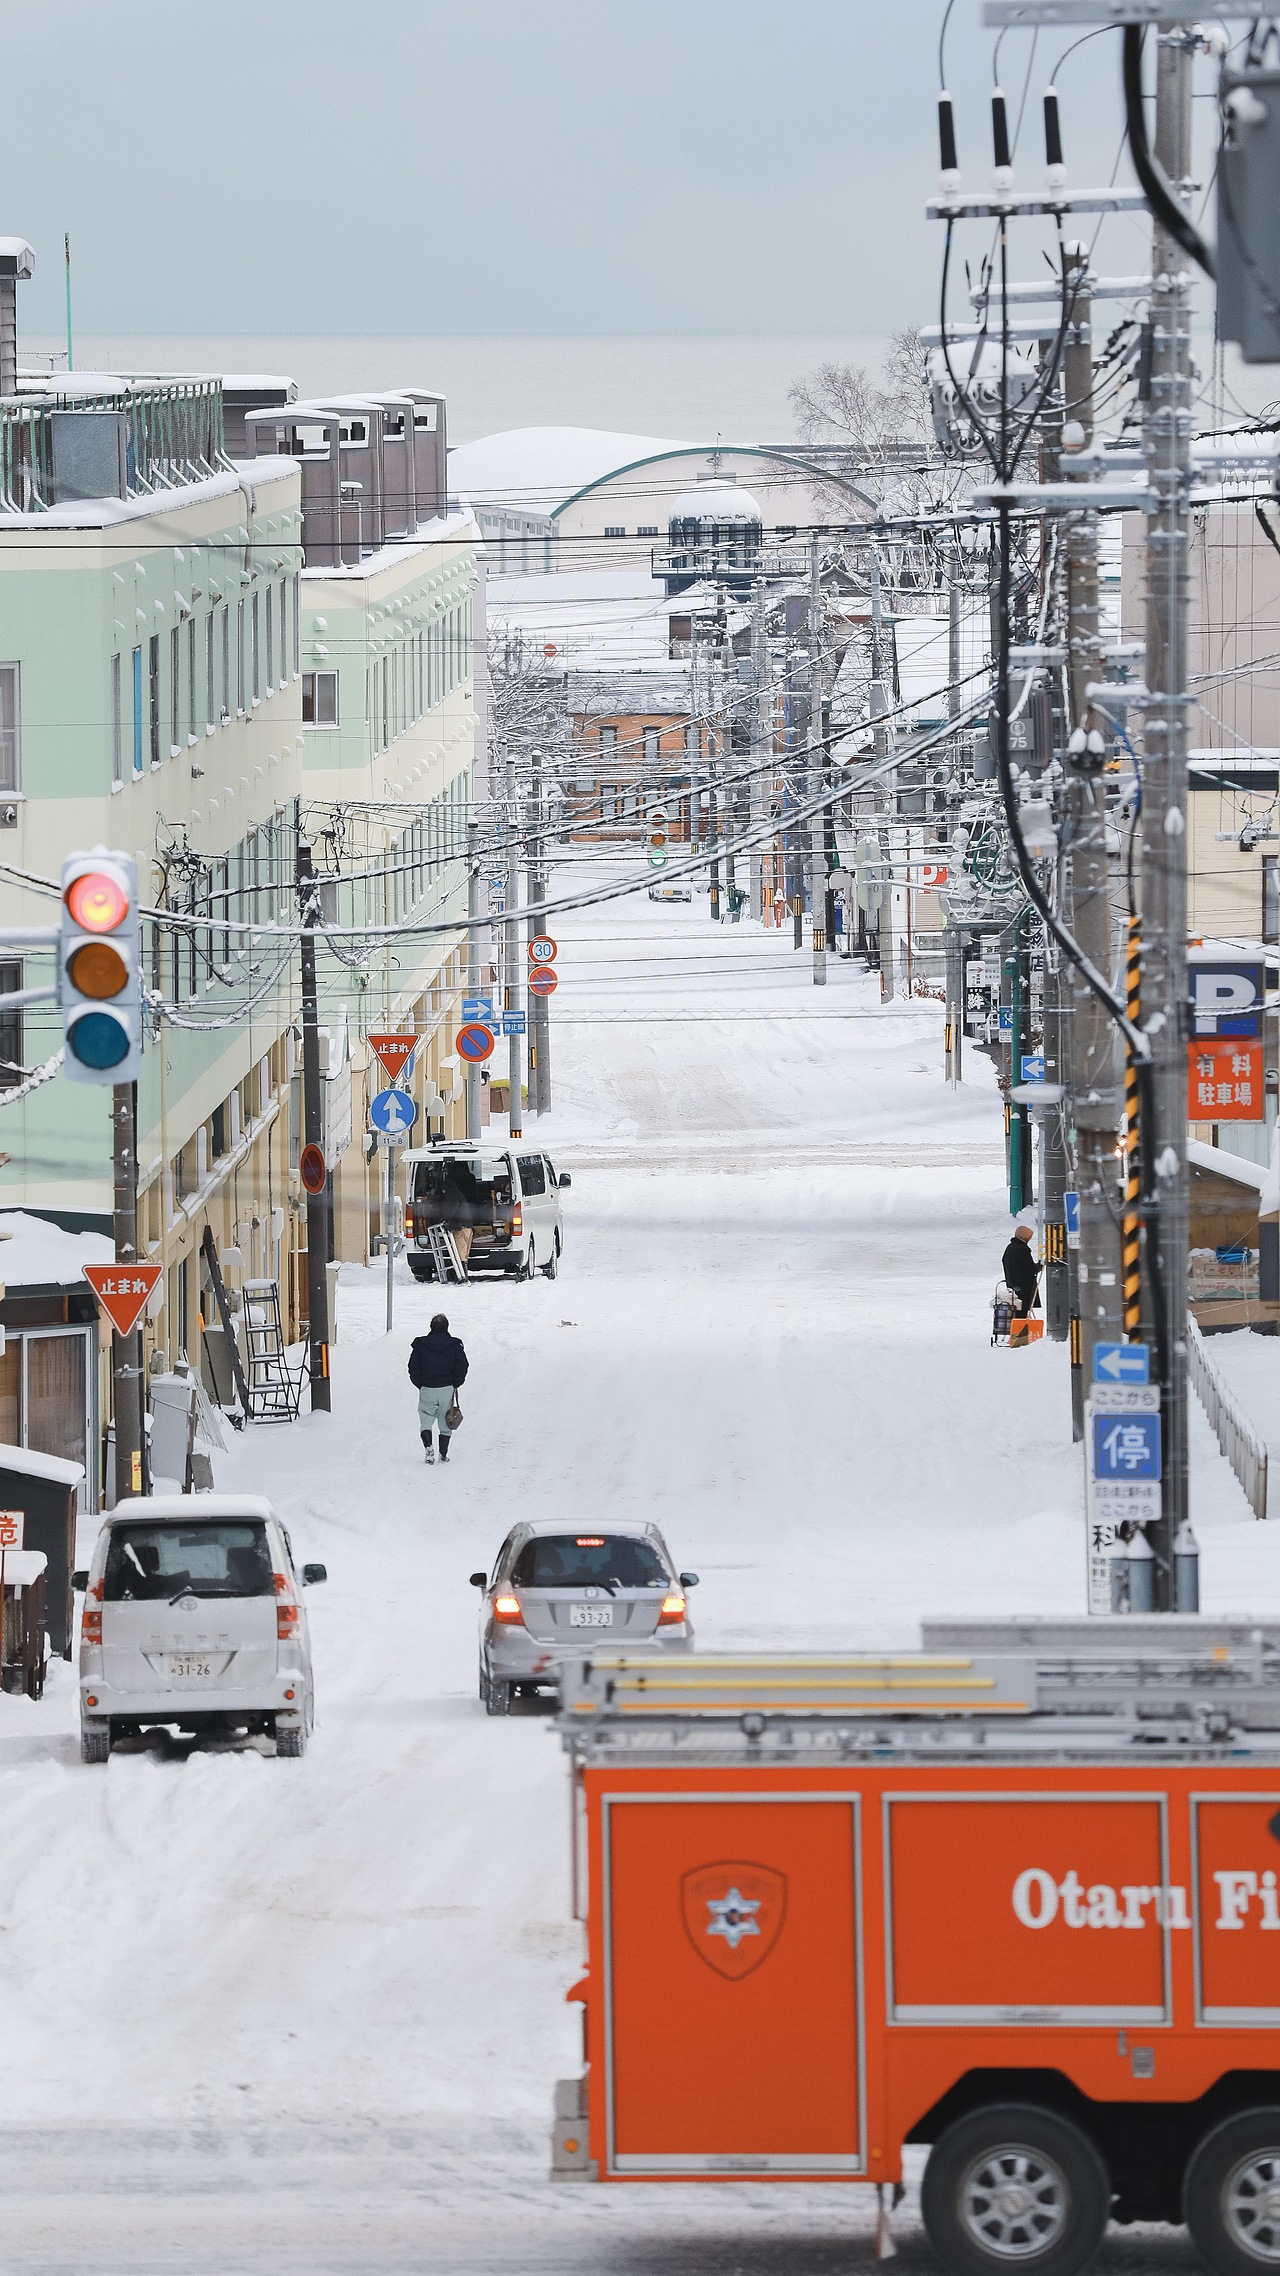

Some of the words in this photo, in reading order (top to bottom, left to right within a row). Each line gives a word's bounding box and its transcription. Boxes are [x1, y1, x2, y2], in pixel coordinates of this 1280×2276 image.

[1009, 736, 1028, 748] 75
[535, 943, 551, 957] 30
[1195, 974, 1257, 1034] P
[378, 1042, 410, 1054] 止まれ
[1196, 1053, 1252, 1078] 有料
[1197, 1082, 1252, 1106] 駐車場
[100, 1277, 149, 1295] 止まれ
[1096, 1391, 1156, 1406] ここから
[1102, 1424, 1150, 1470] 停
[1101, 1504, 1155, 1517] ここから
[580, 1613, 611, 1624] 93-23
[178, 1664, 211, 1676] 31-26
[1012, 1868, 1191, 1929] Otaru
[1213, 1870, 1280, 1930] Fi
